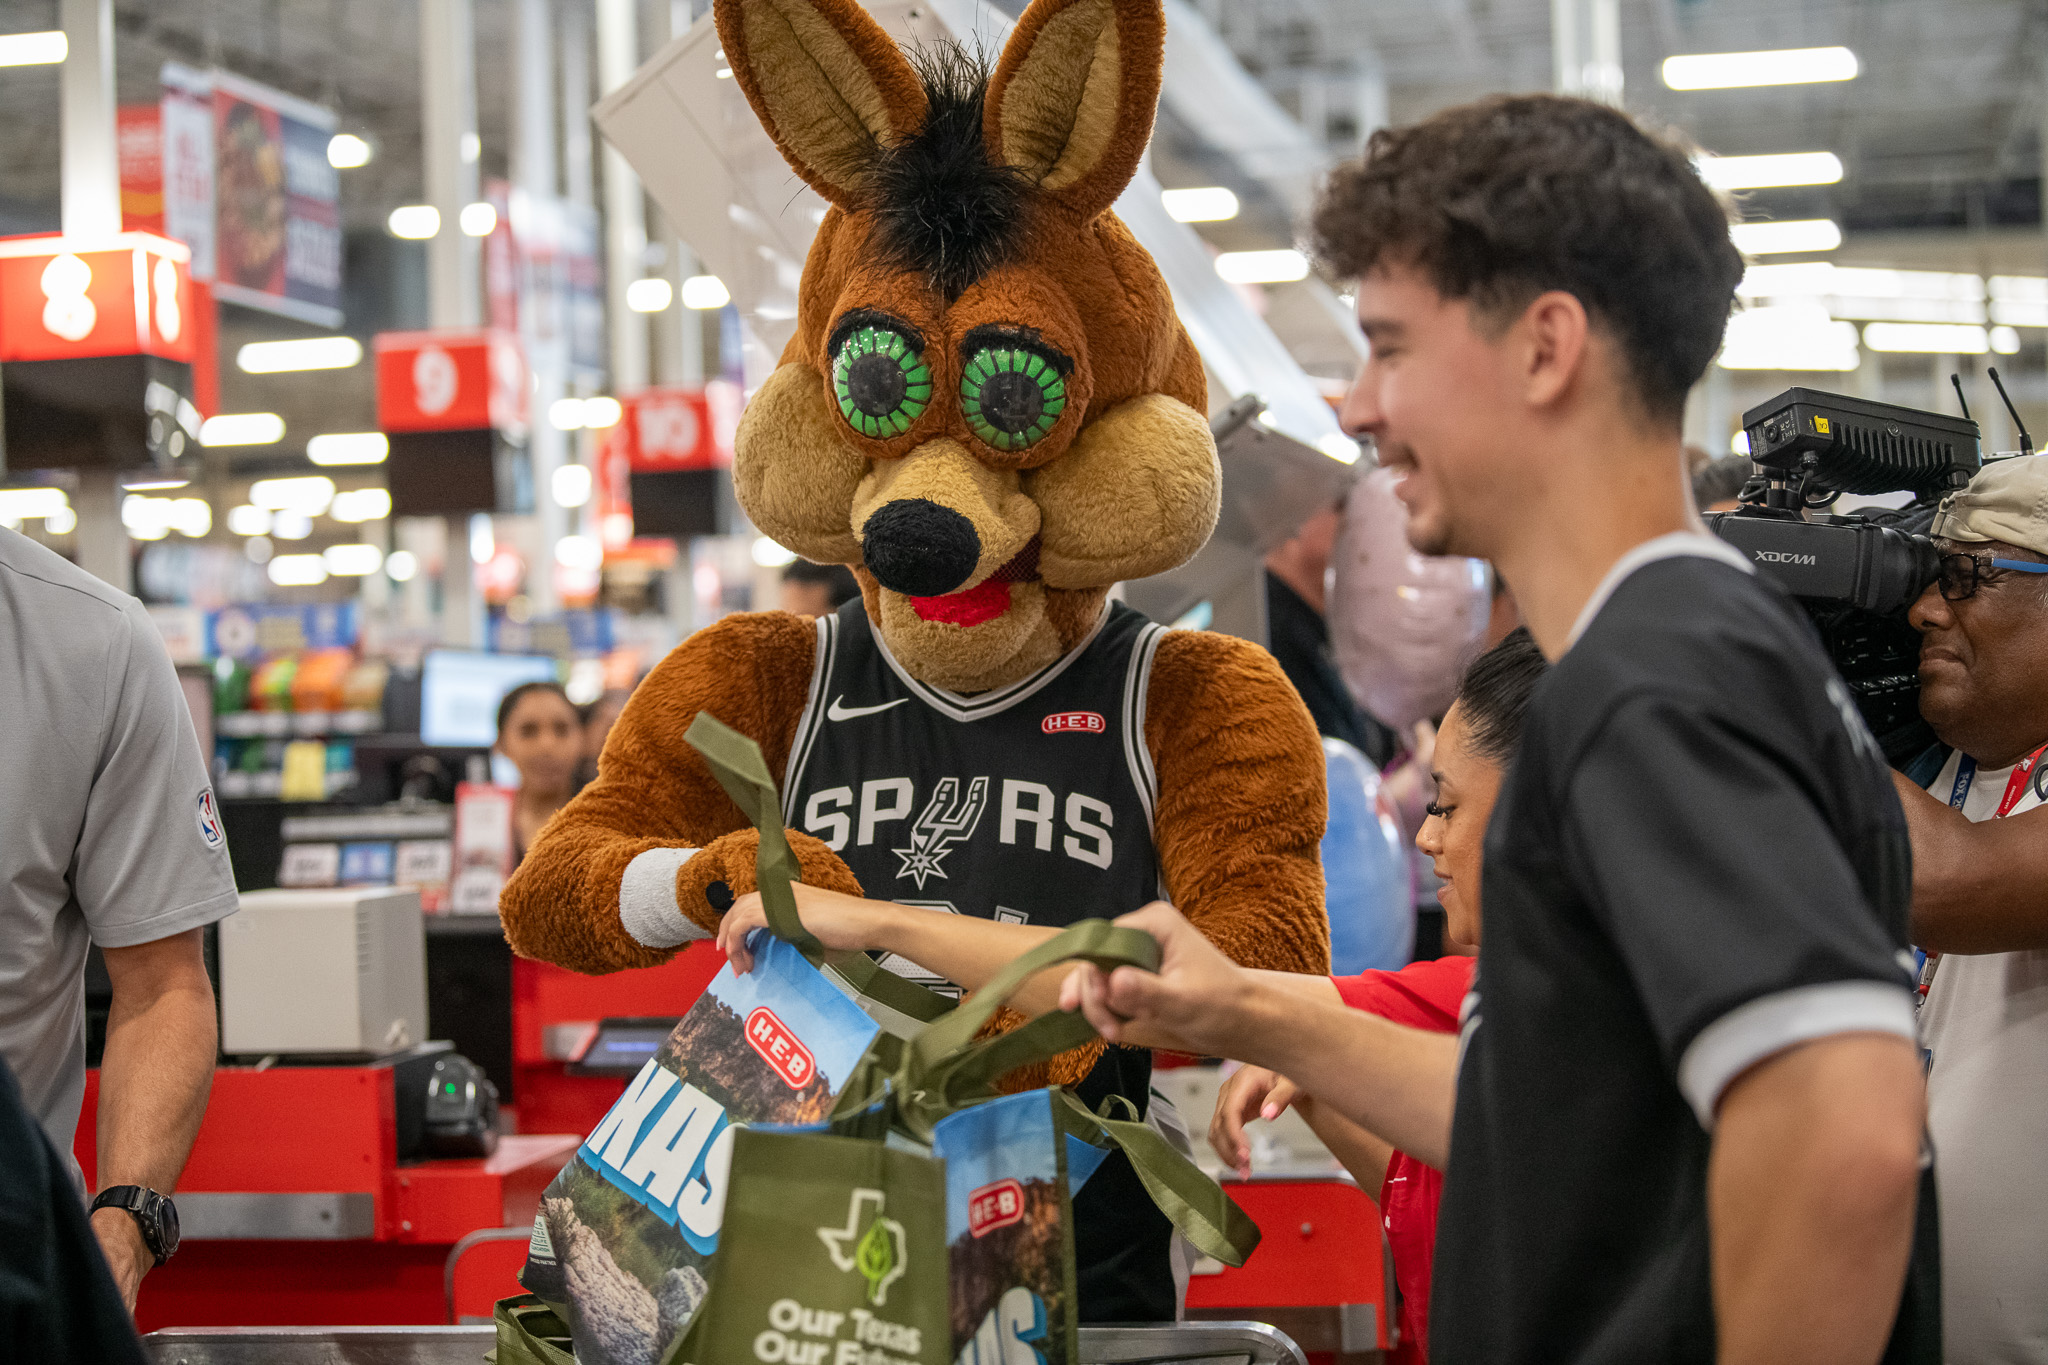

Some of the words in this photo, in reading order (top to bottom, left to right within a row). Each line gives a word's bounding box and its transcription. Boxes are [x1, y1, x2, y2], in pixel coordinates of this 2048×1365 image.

[41, 253, 97, 341] 8
[413, 347, 459, 416] 9
[1755, 550, 1816, 566] XDCAM
[1047, 715, 1100, 730] H-E-B
[1956, 772, 1970, 796] FOX
[804, 776, 1113, 890] SPURS
[754, 1330, 830, 1365] Our
[768, 1299, 845, 1337] Our
[851, 1308, 921, 1355] Texas
